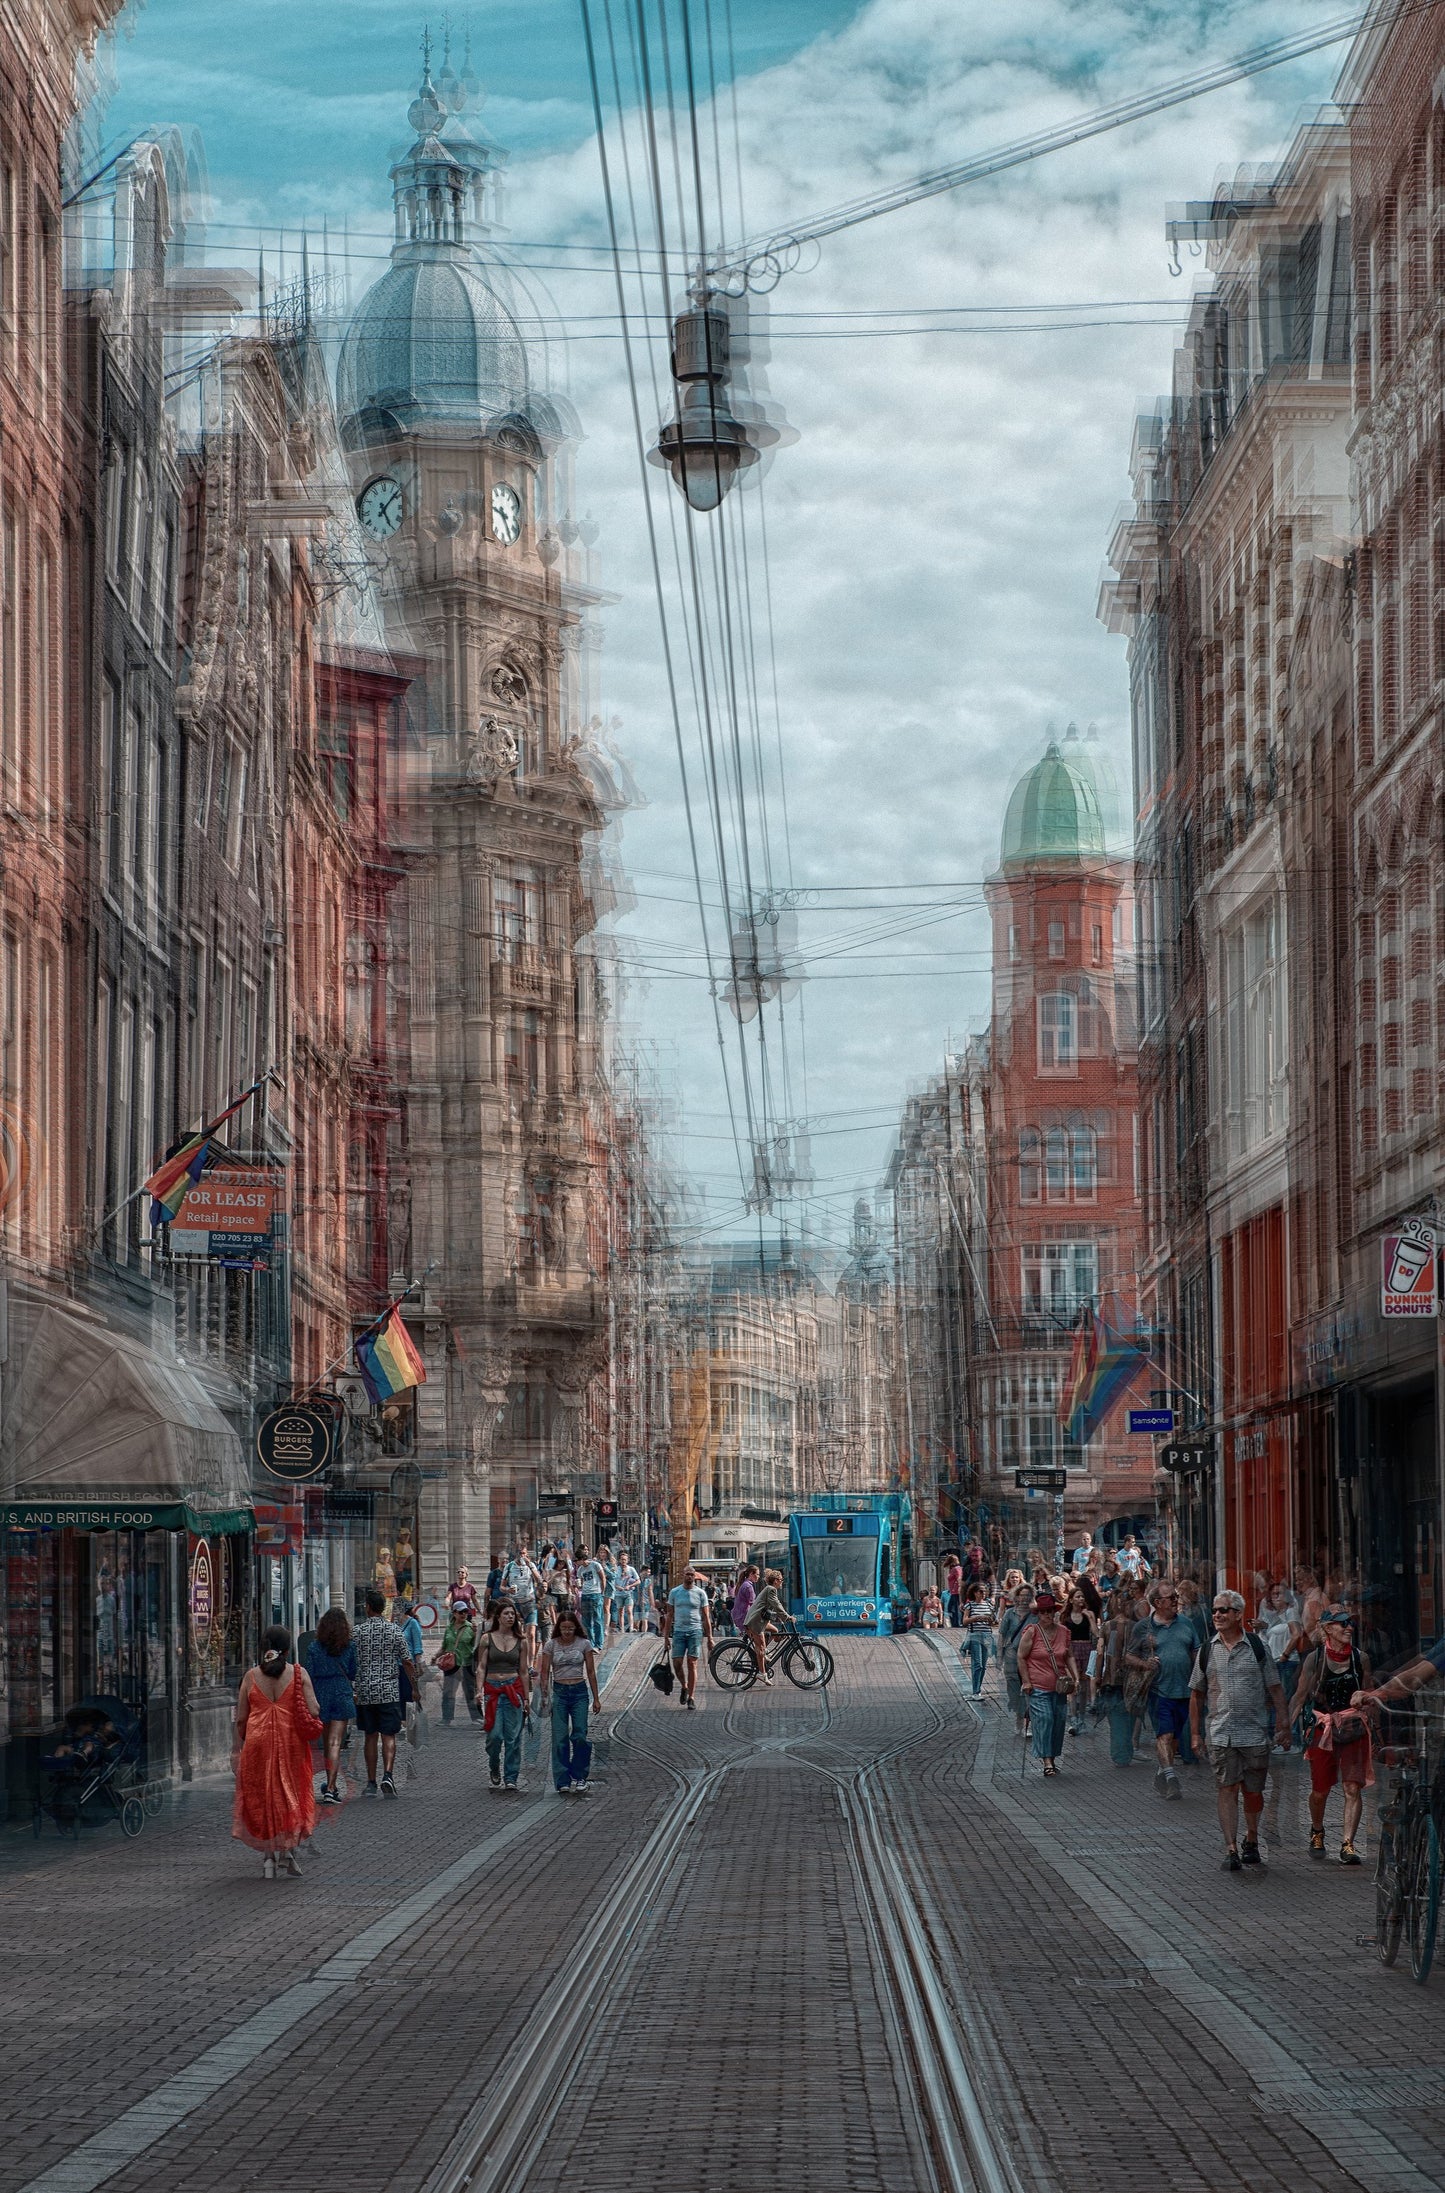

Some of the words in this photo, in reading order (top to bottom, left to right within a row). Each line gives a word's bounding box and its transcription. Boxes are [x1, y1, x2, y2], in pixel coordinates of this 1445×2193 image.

[216, 1192, 265, 1207] LEASE
[187, 1212, 218, 1223] Retail
[222, 1215, 255, 1227] space
[211, 1233, 225, 1241] 020
[227, 1234, 241, 1242] 705
[1385, 1295, 1435, 1304] DUNKIN'
[1385, 1305, 1433, 1314] DONUTS
[274, 1436, 312, 1444] BURGERS
[1169, 1451, 1178, 1464] P
[1182, 1452, 1190, 1463] &
[1194, 1450, 1203, 1464] T
[24, 1512, 53, 1524] AND
[57, 1512, 110, 1524] BRITISH
[114, 1512, 153, 1524] FOOD
[836, 1519, 844, 1531] 2
[817, 1599, 836, 1608] Kom
[837, 1599, 866, 1608] werken
[826, 1609, 837, 1618] bij
